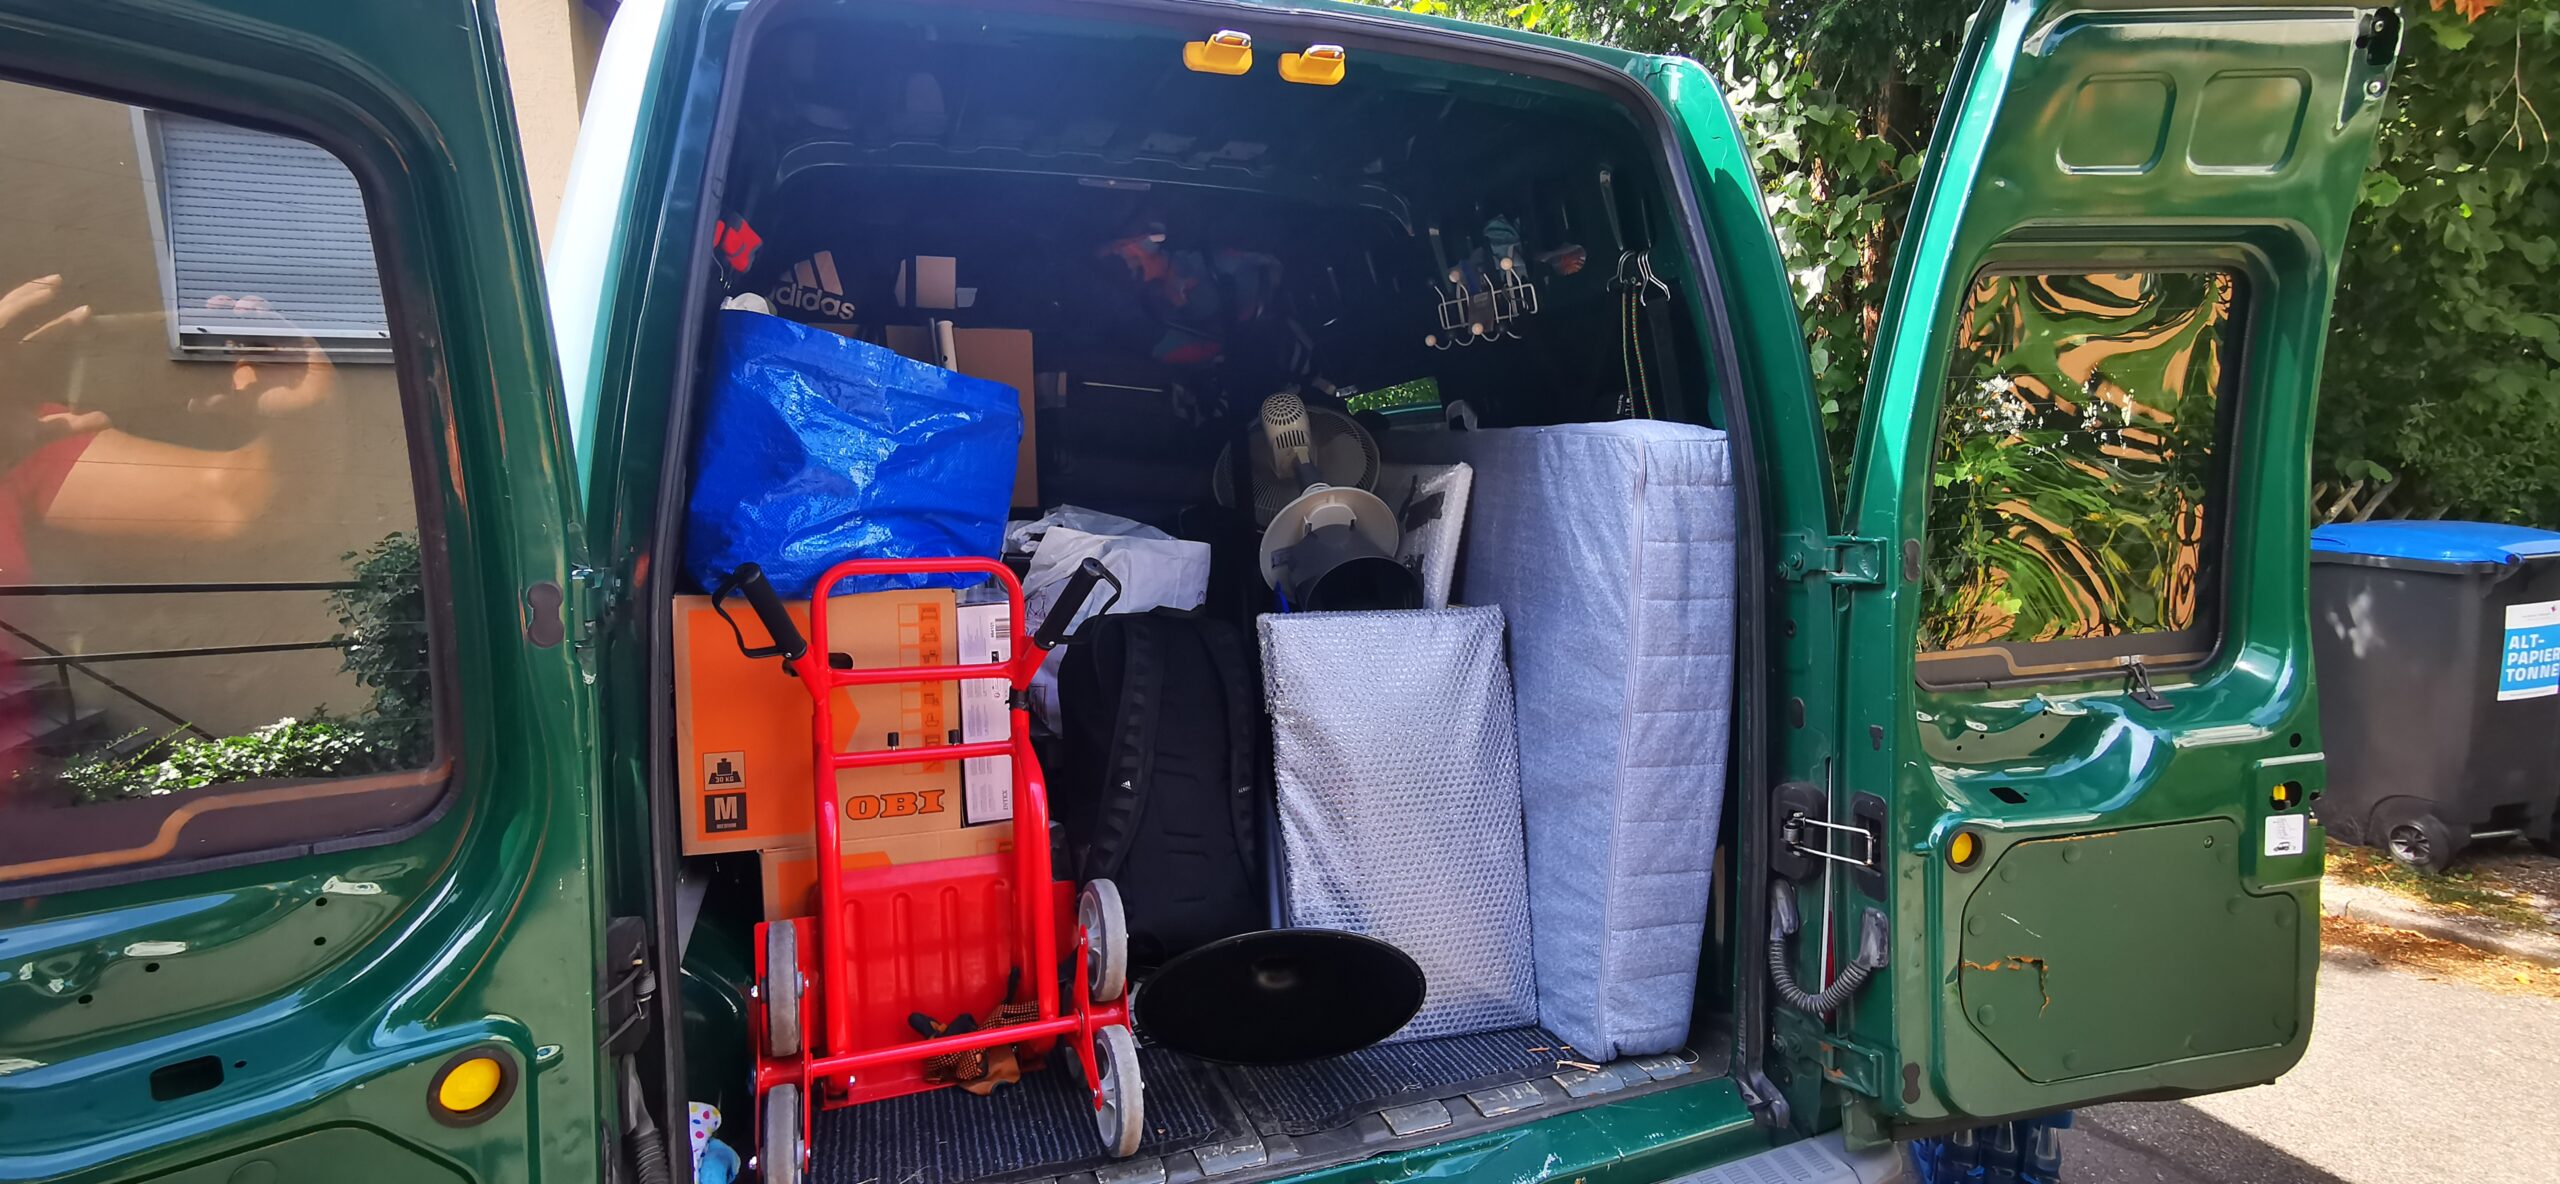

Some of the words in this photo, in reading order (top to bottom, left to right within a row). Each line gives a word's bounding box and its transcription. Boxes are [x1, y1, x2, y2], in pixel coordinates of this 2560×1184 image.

[2508, 634, 2545, 649] ALT-
[2507, 647, 2560, 666] PAPIER
[2505, 663, 2560, 682] TONNE
[714, 796, 738, 821] M
[846, 789, 945, 820] OBI
